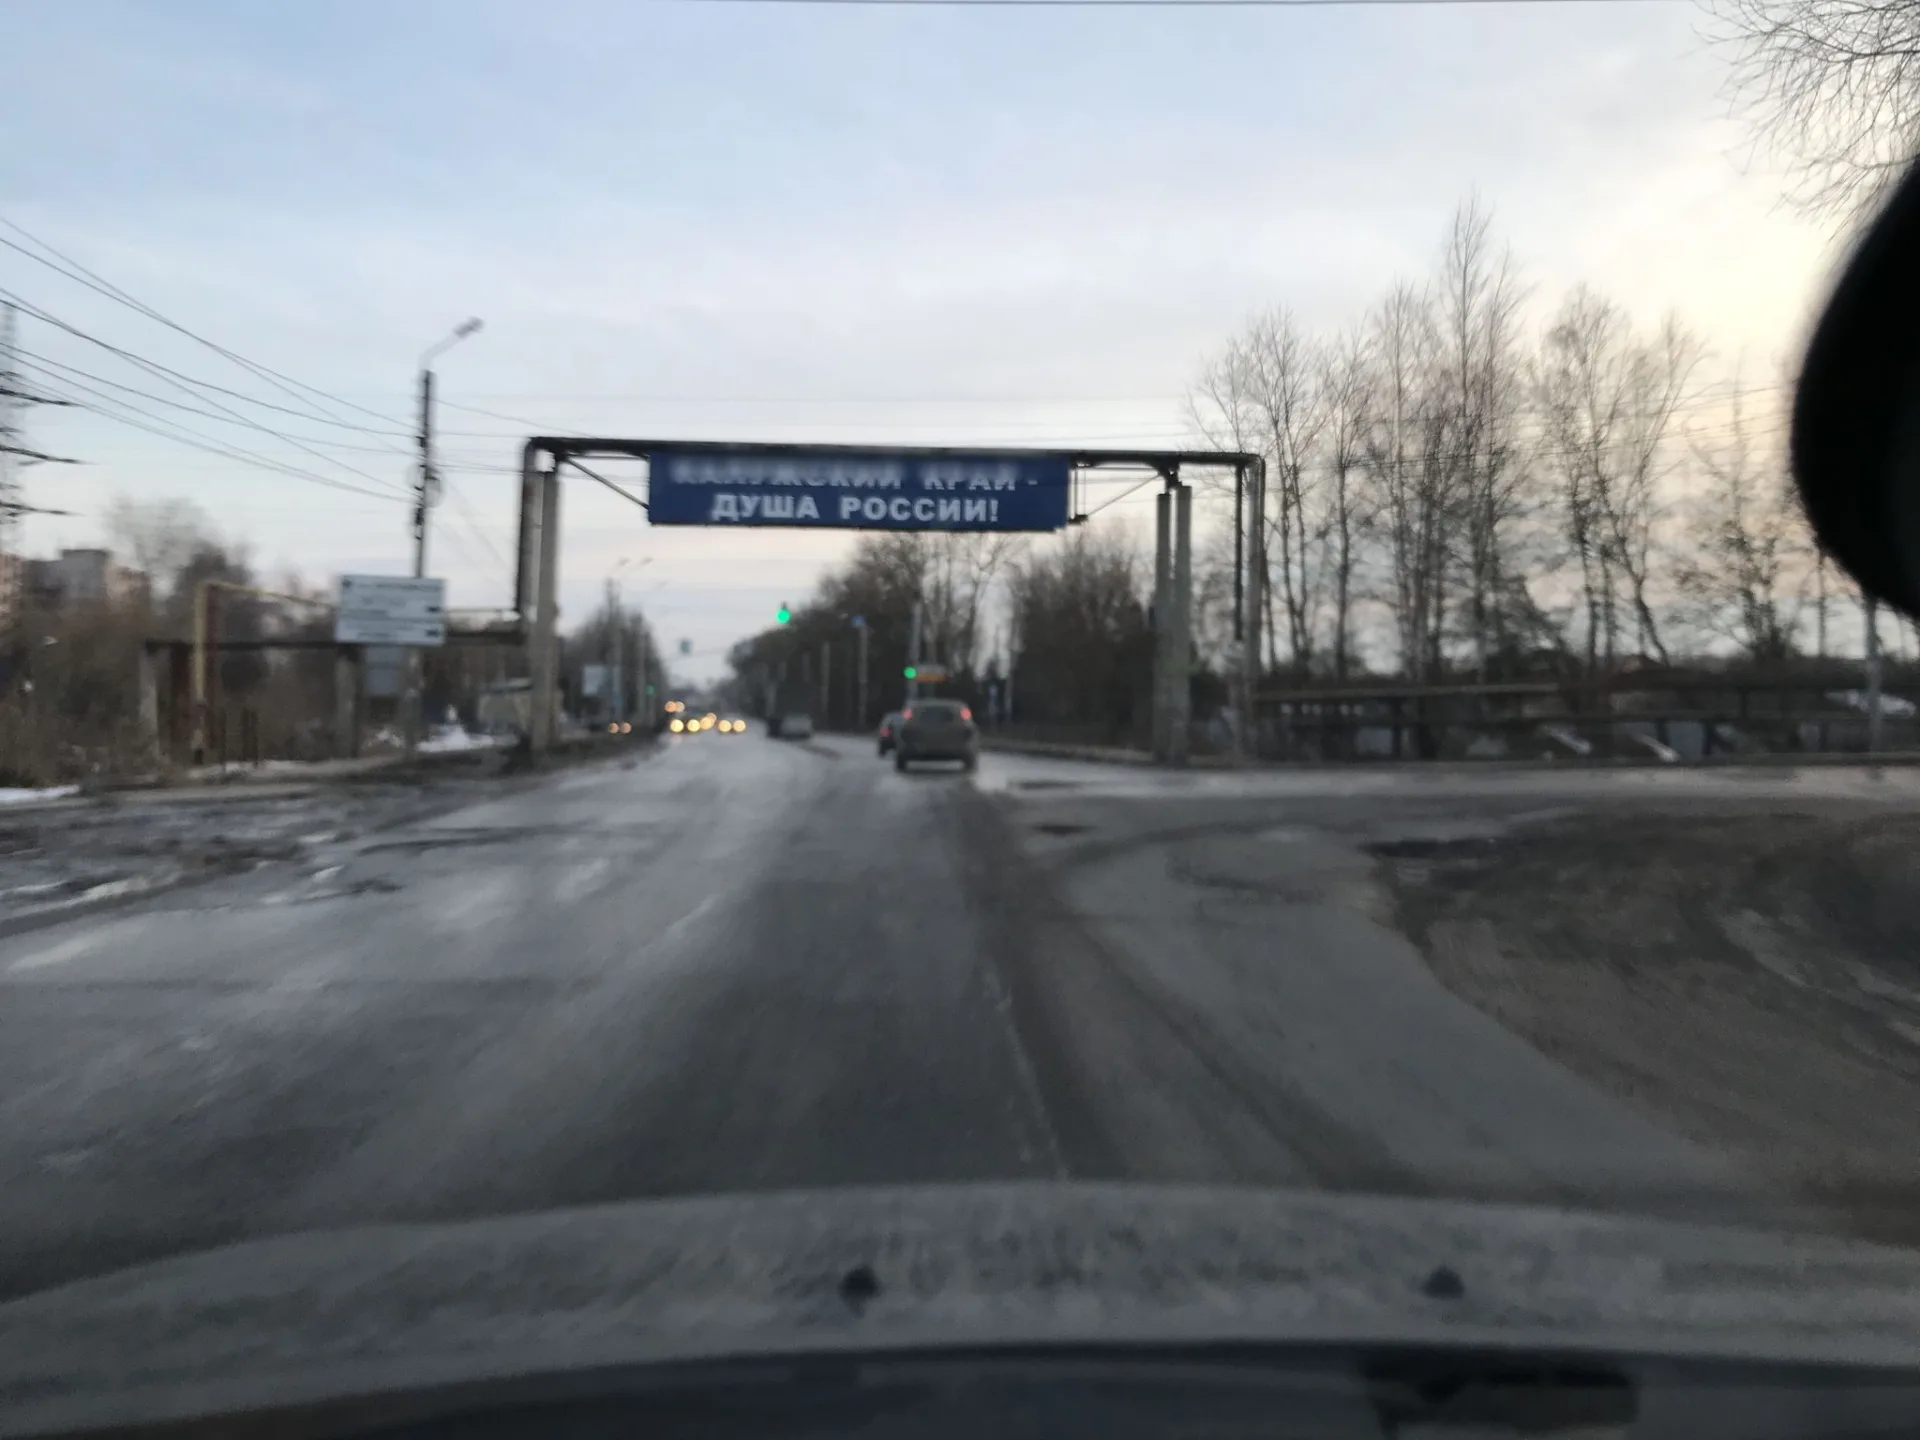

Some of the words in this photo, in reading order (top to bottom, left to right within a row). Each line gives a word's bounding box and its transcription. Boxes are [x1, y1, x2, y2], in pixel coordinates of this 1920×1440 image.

[671, 460, 902, 488] ЖСКИЙ
[710, 493, 820, 522] ДУША
[839, 496, 1000, 523] РОССИИ!
